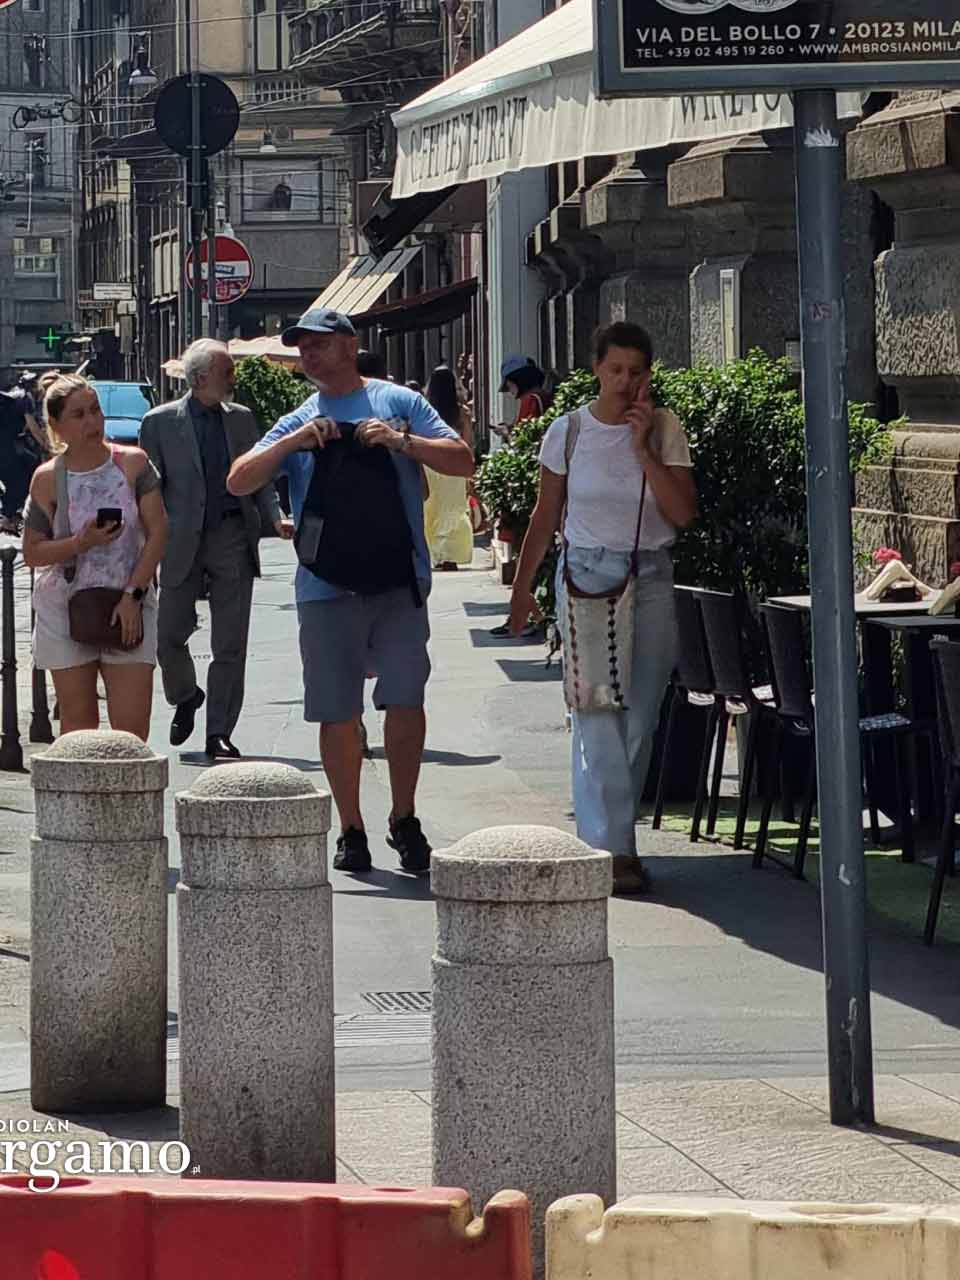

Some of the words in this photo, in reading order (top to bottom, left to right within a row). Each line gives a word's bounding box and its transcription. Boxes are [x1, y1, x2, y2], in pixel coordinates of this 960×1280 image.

[636, 27, 673, 43] VIA
[681, 25, 722, 42] DEL
[729, 24, 801, 41] BOLLO
[809, 24, 821, 39] 7
[844, 22, 905, 39] 20123
[636, 48, 663, 59] TEL.
[668, 47, 690, 57] +39
[695, 47, 710, 57] 02
[715, 46, 738, 56] 495
[744, 46, 756, 56] 19
[760, 45, 784, 55] 260
